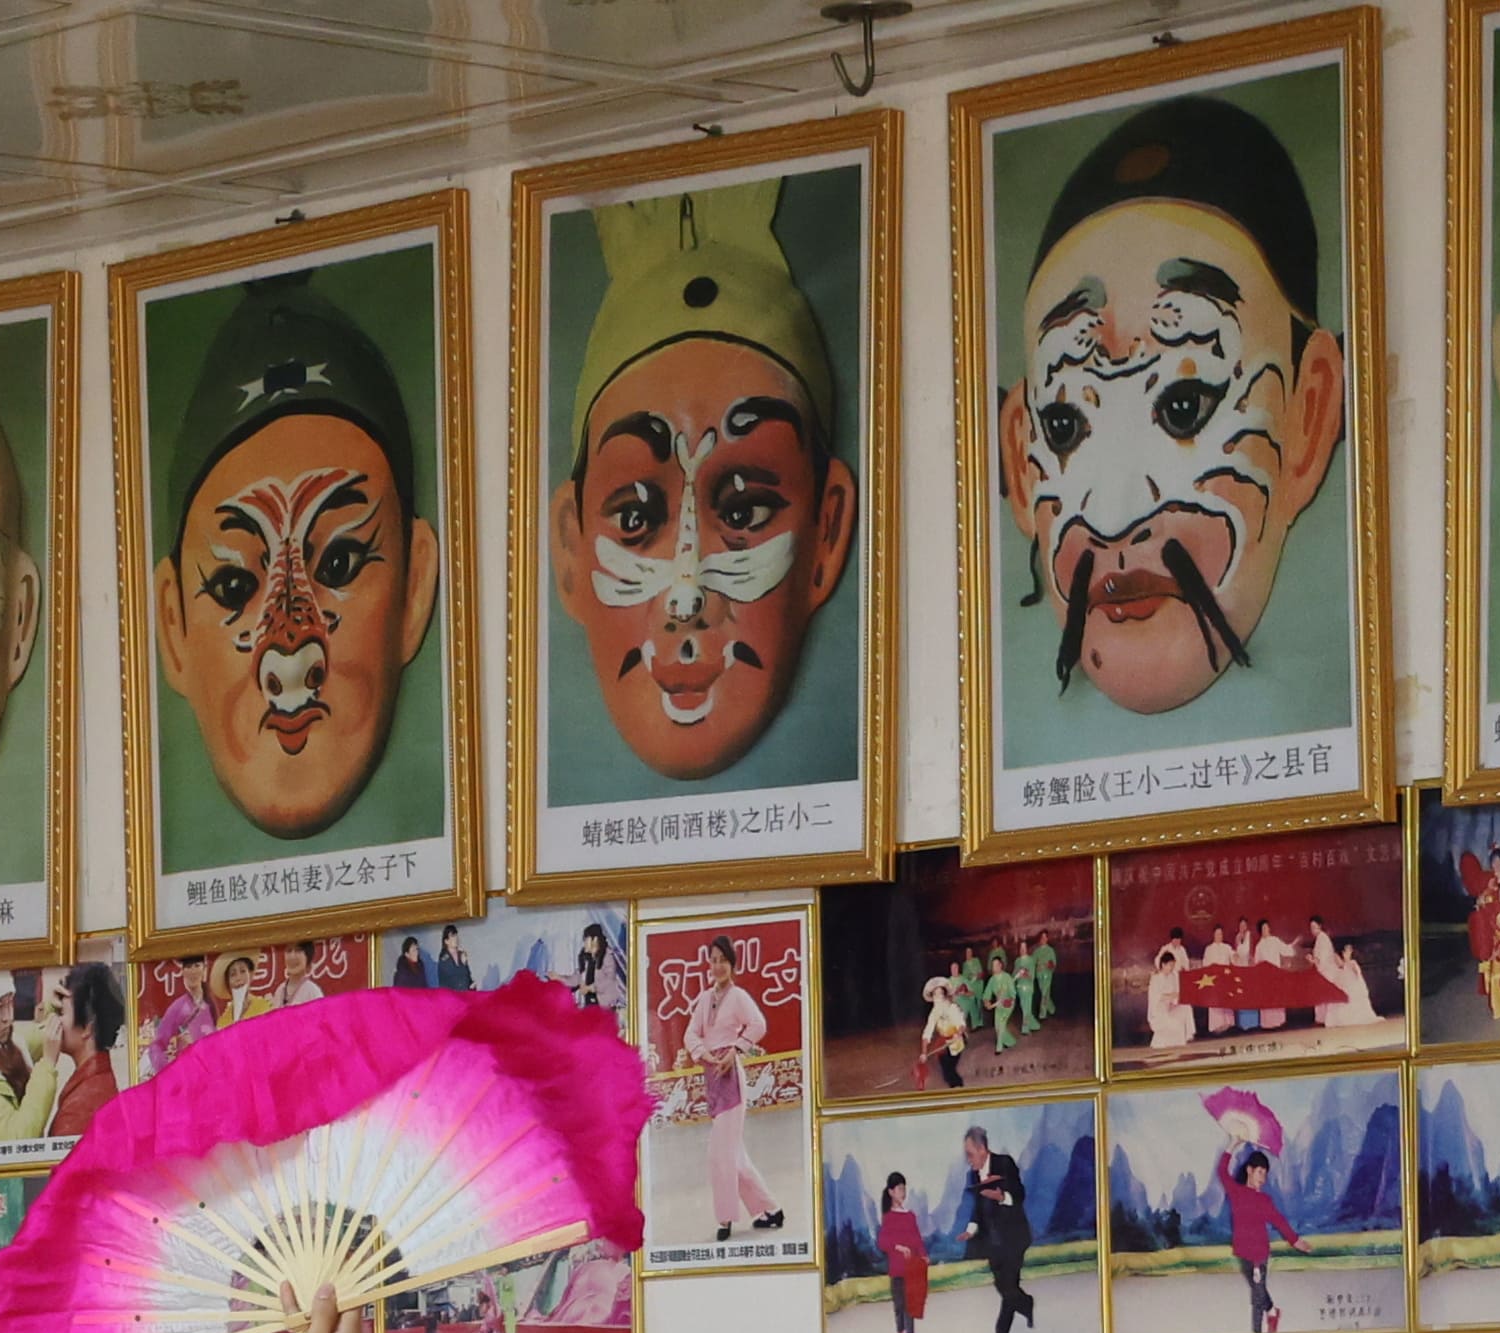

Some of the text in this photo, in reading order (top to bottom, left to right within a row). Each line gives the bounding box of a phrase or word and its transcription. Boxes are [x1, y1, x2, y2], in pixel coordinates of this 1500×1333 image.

[1022, 742, 1334, 809] 螃蟹脸《王小二过年》之县官
[580, 801, 834, 850] 蜻蜓脸《闹酒楼》之店小二
[186, 852, 418, 904] 鲤鱼脸《双怕妻》之余子下
